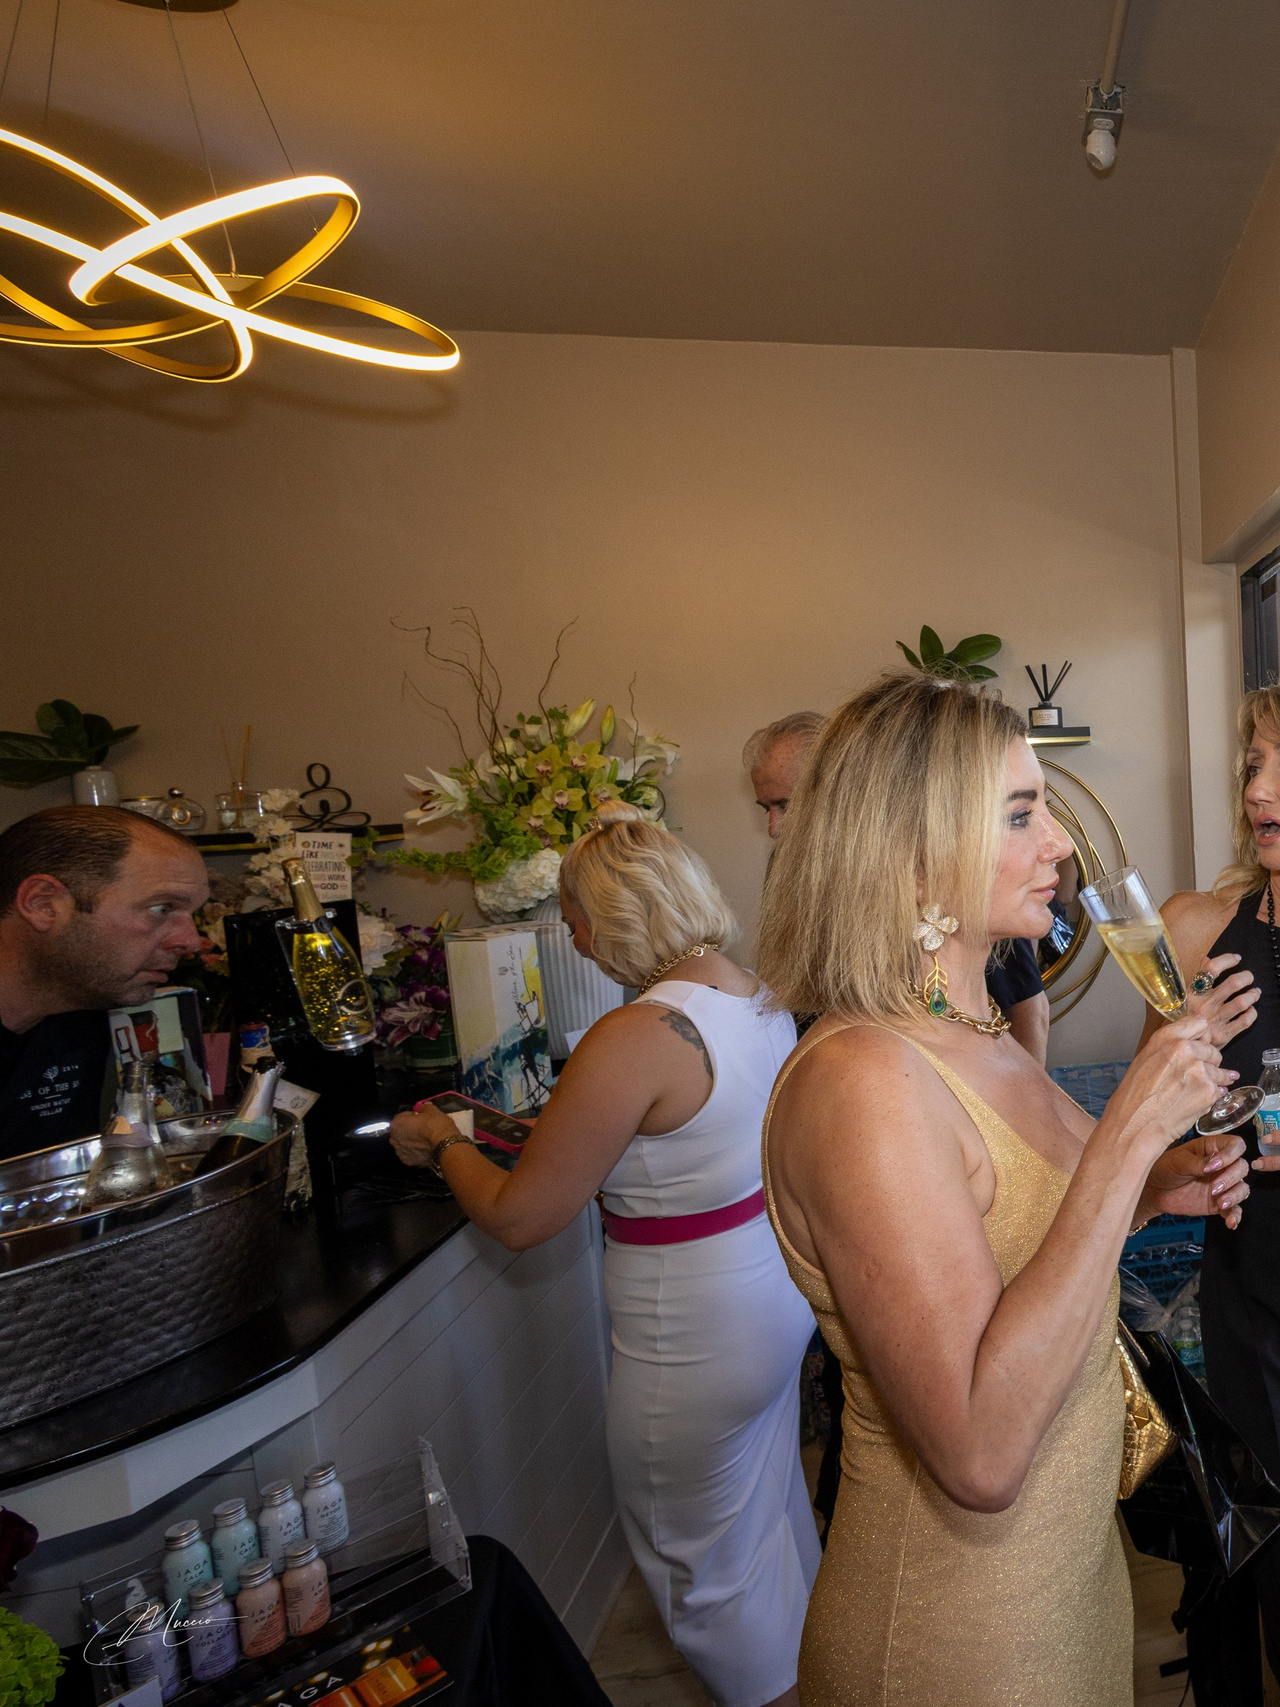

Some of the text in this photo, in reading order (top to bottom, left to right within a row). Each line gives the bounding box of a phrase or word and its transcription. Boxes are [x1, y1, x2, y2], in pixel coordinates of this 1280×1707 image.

[312, 841, 334, 849] TIME
[304, 860, 346, 873] LEBRATING
[320, 882, 339, 890] GOD
[38, 1086, 51, 1095] OF
[54, 1083, 69, 1092] THE
[316, 1497, 343, 1514] JAGA
[320, 1506, 341, 1519] DETOX
[176, 1559, 208, 1578] JAGA
[183, 1569, 204, 1583] CALM
